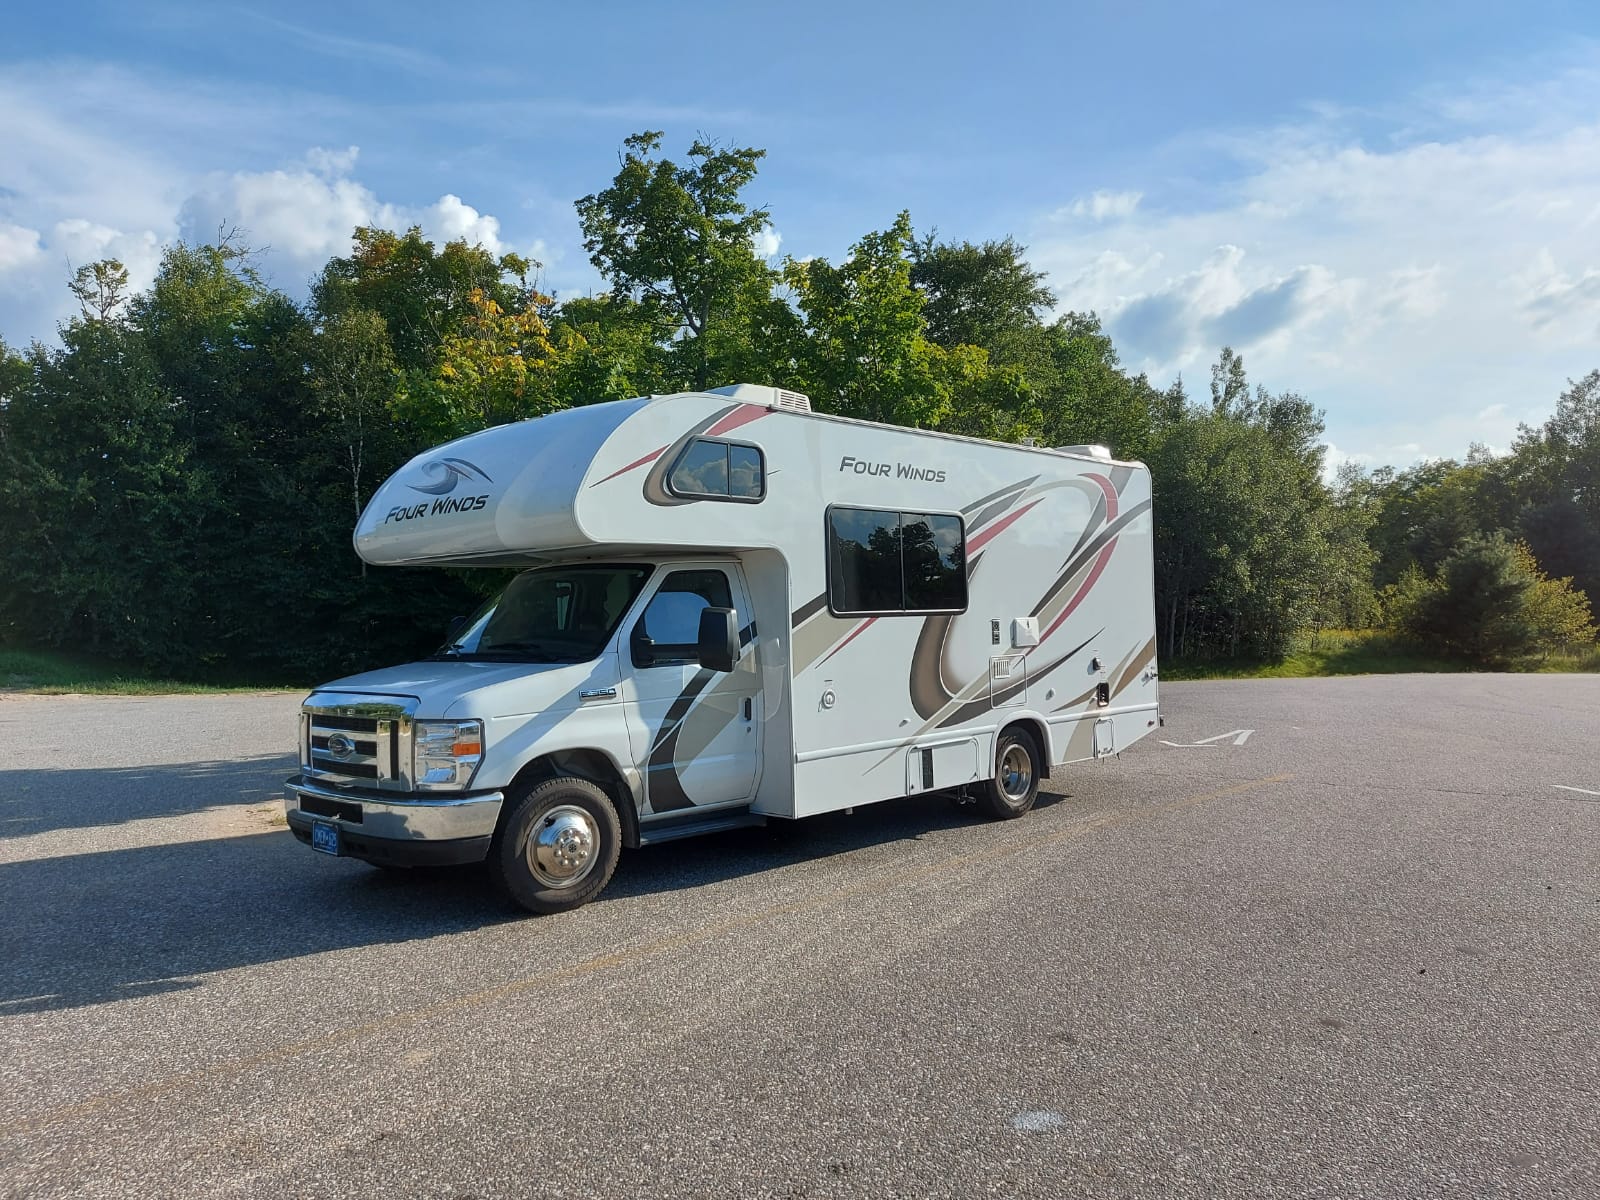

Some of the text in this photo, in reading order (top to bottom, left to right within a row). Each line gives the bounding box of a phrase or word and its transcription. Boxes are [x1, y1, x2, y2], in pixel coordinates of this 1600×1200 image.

[839, 456, 946, 483] FOUR WINDS
[384, 495, 490, 524] FOUR WINDS
